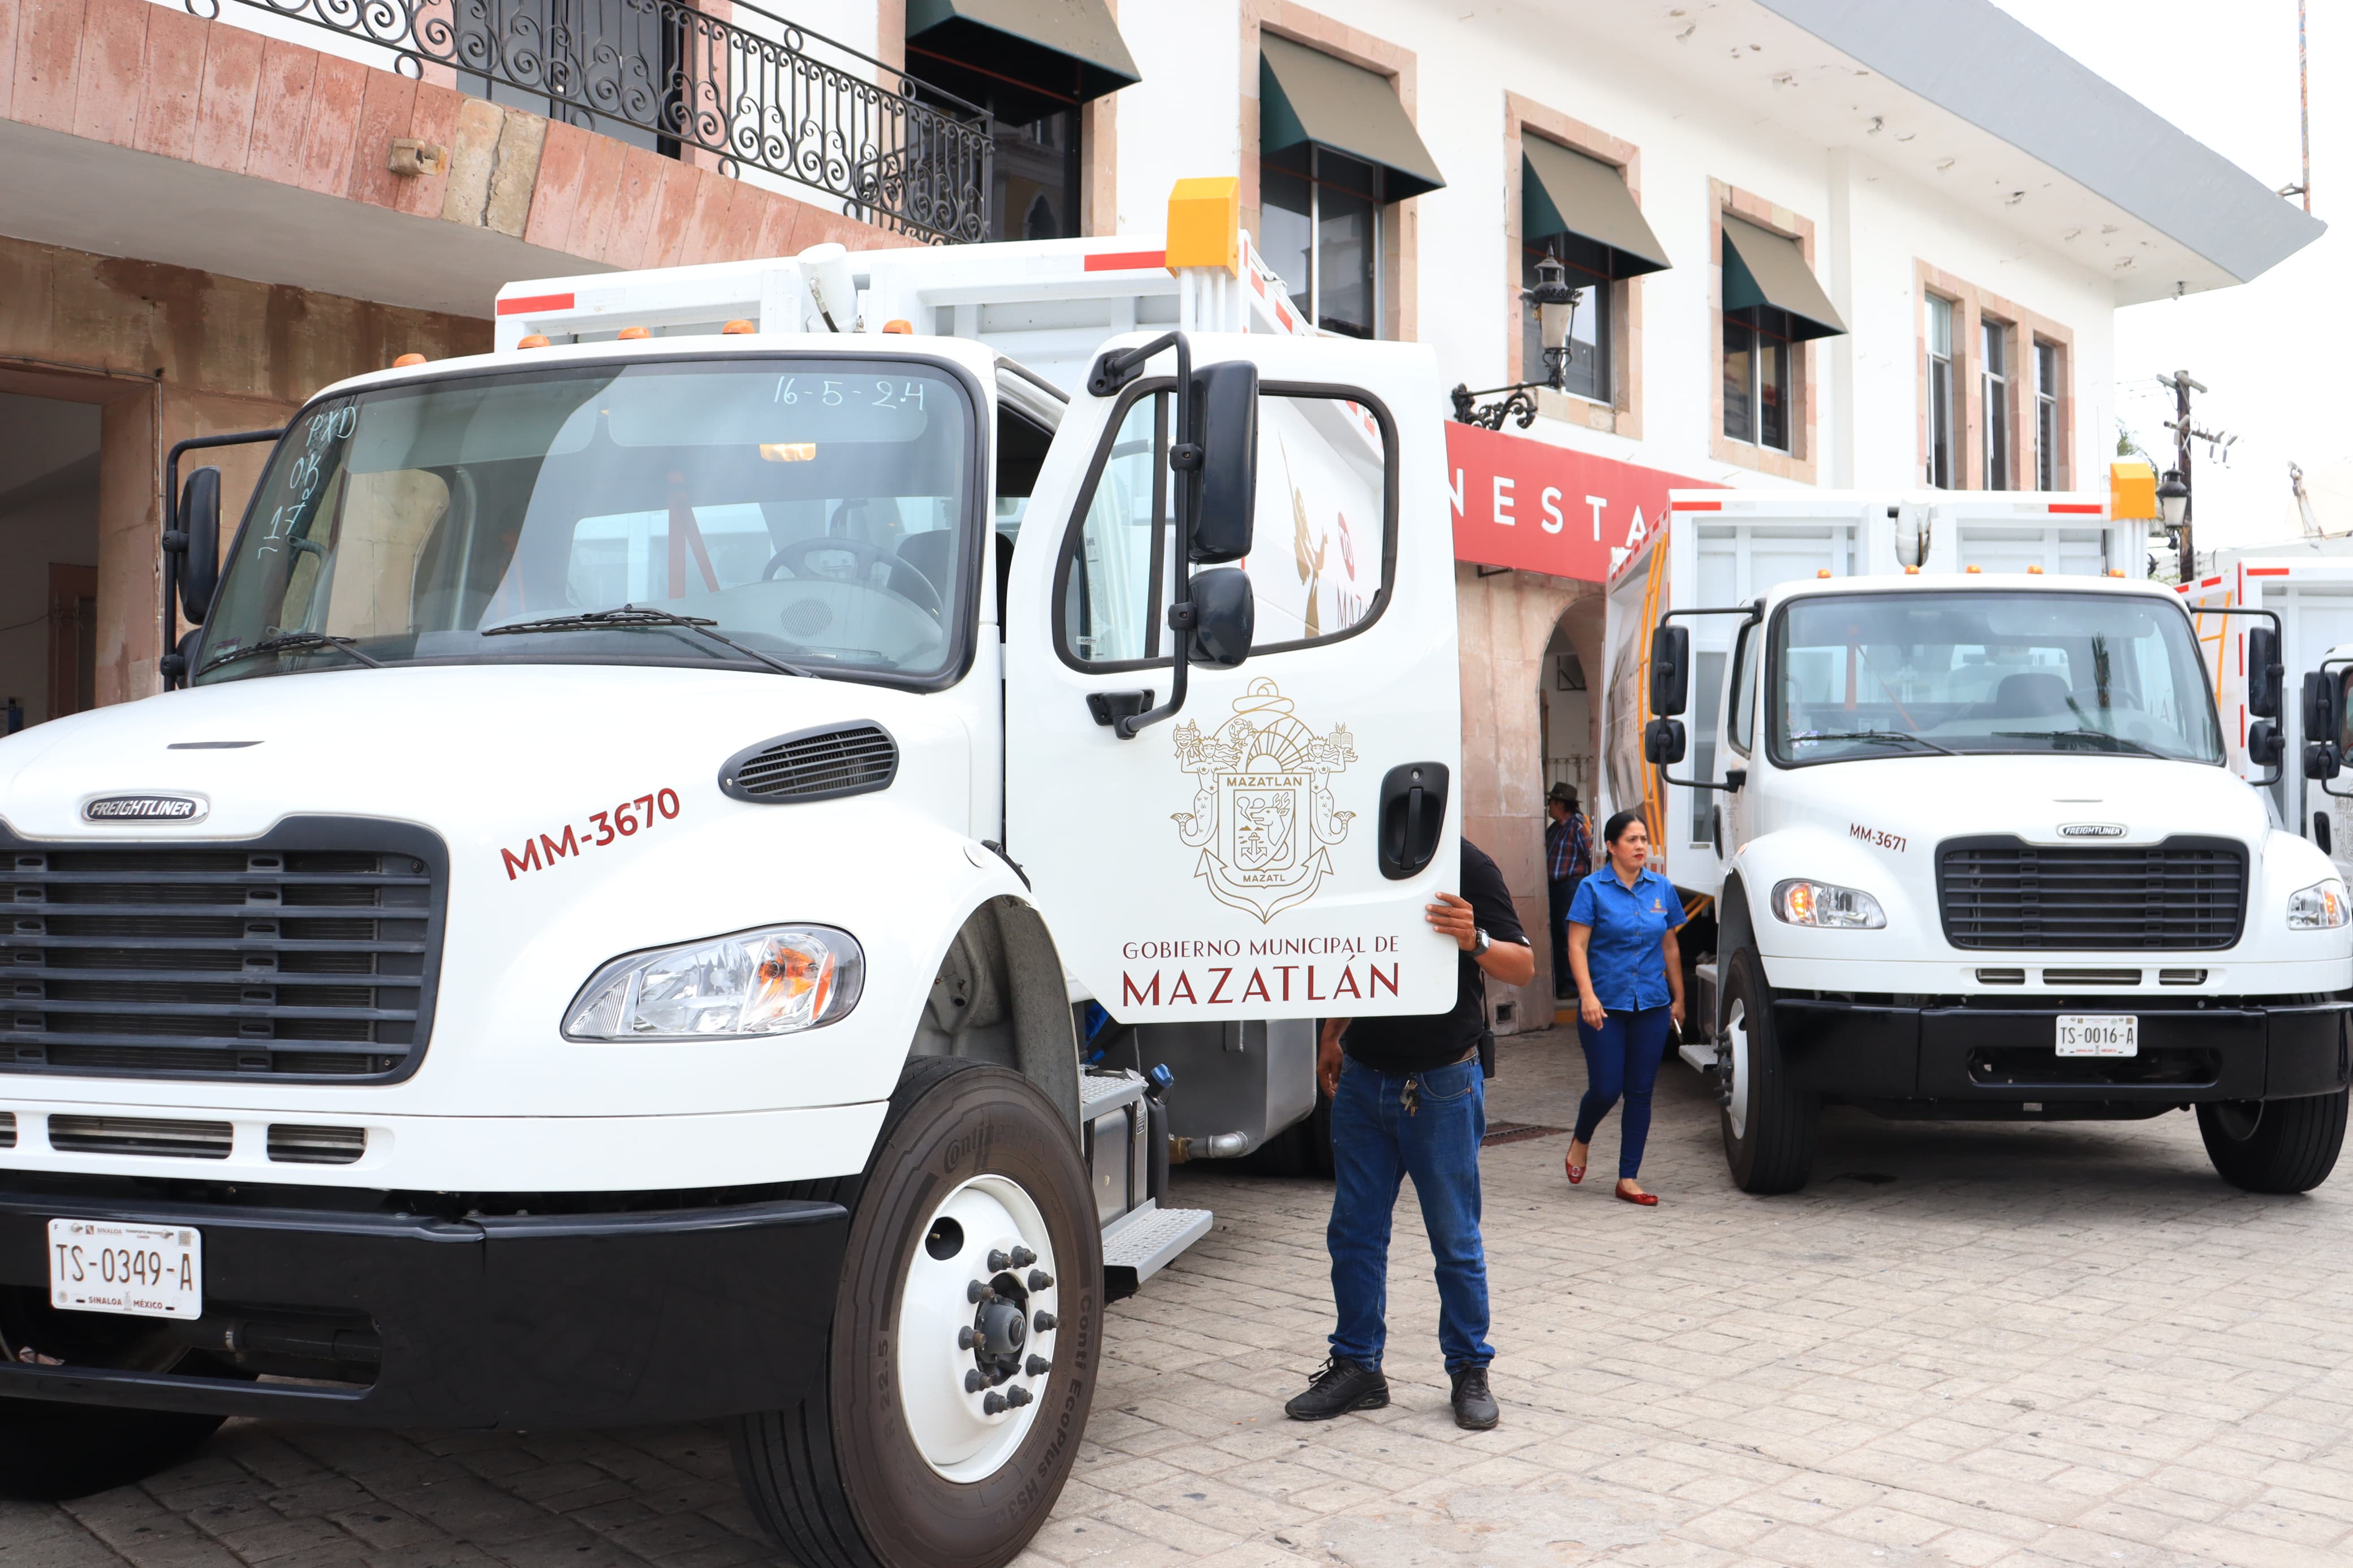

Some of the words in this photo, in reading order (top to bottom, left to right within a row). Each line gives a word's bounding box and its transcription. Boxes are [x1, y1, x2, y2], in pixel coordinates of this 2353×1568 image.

[1226, 776, 1303, 787] MAZATLAN
[90, 800, 193, 816] FREIGHTLINER
[500, 787, 680, 881] MM-3670
[1850, 823, 1907, 853] MM-3671
[1243, 874, 1286, 883] MAZATL
[1122, 939, 1240, 960] GOBIERNO
[1249, 936, 1366, 956] MUNICIPAL
[1374, 935, 1399, 953] DE
[1123, 954, 1399, 1007] MAZATLÁN
[2060, 1027, 2134, 1044] TS-0016-A
[55, 1243, 193, 1291] TS-0349-A
[88, 1296, 122, 1306] SINALOA
[133, 1299, 163, 1310] MÉXICO
